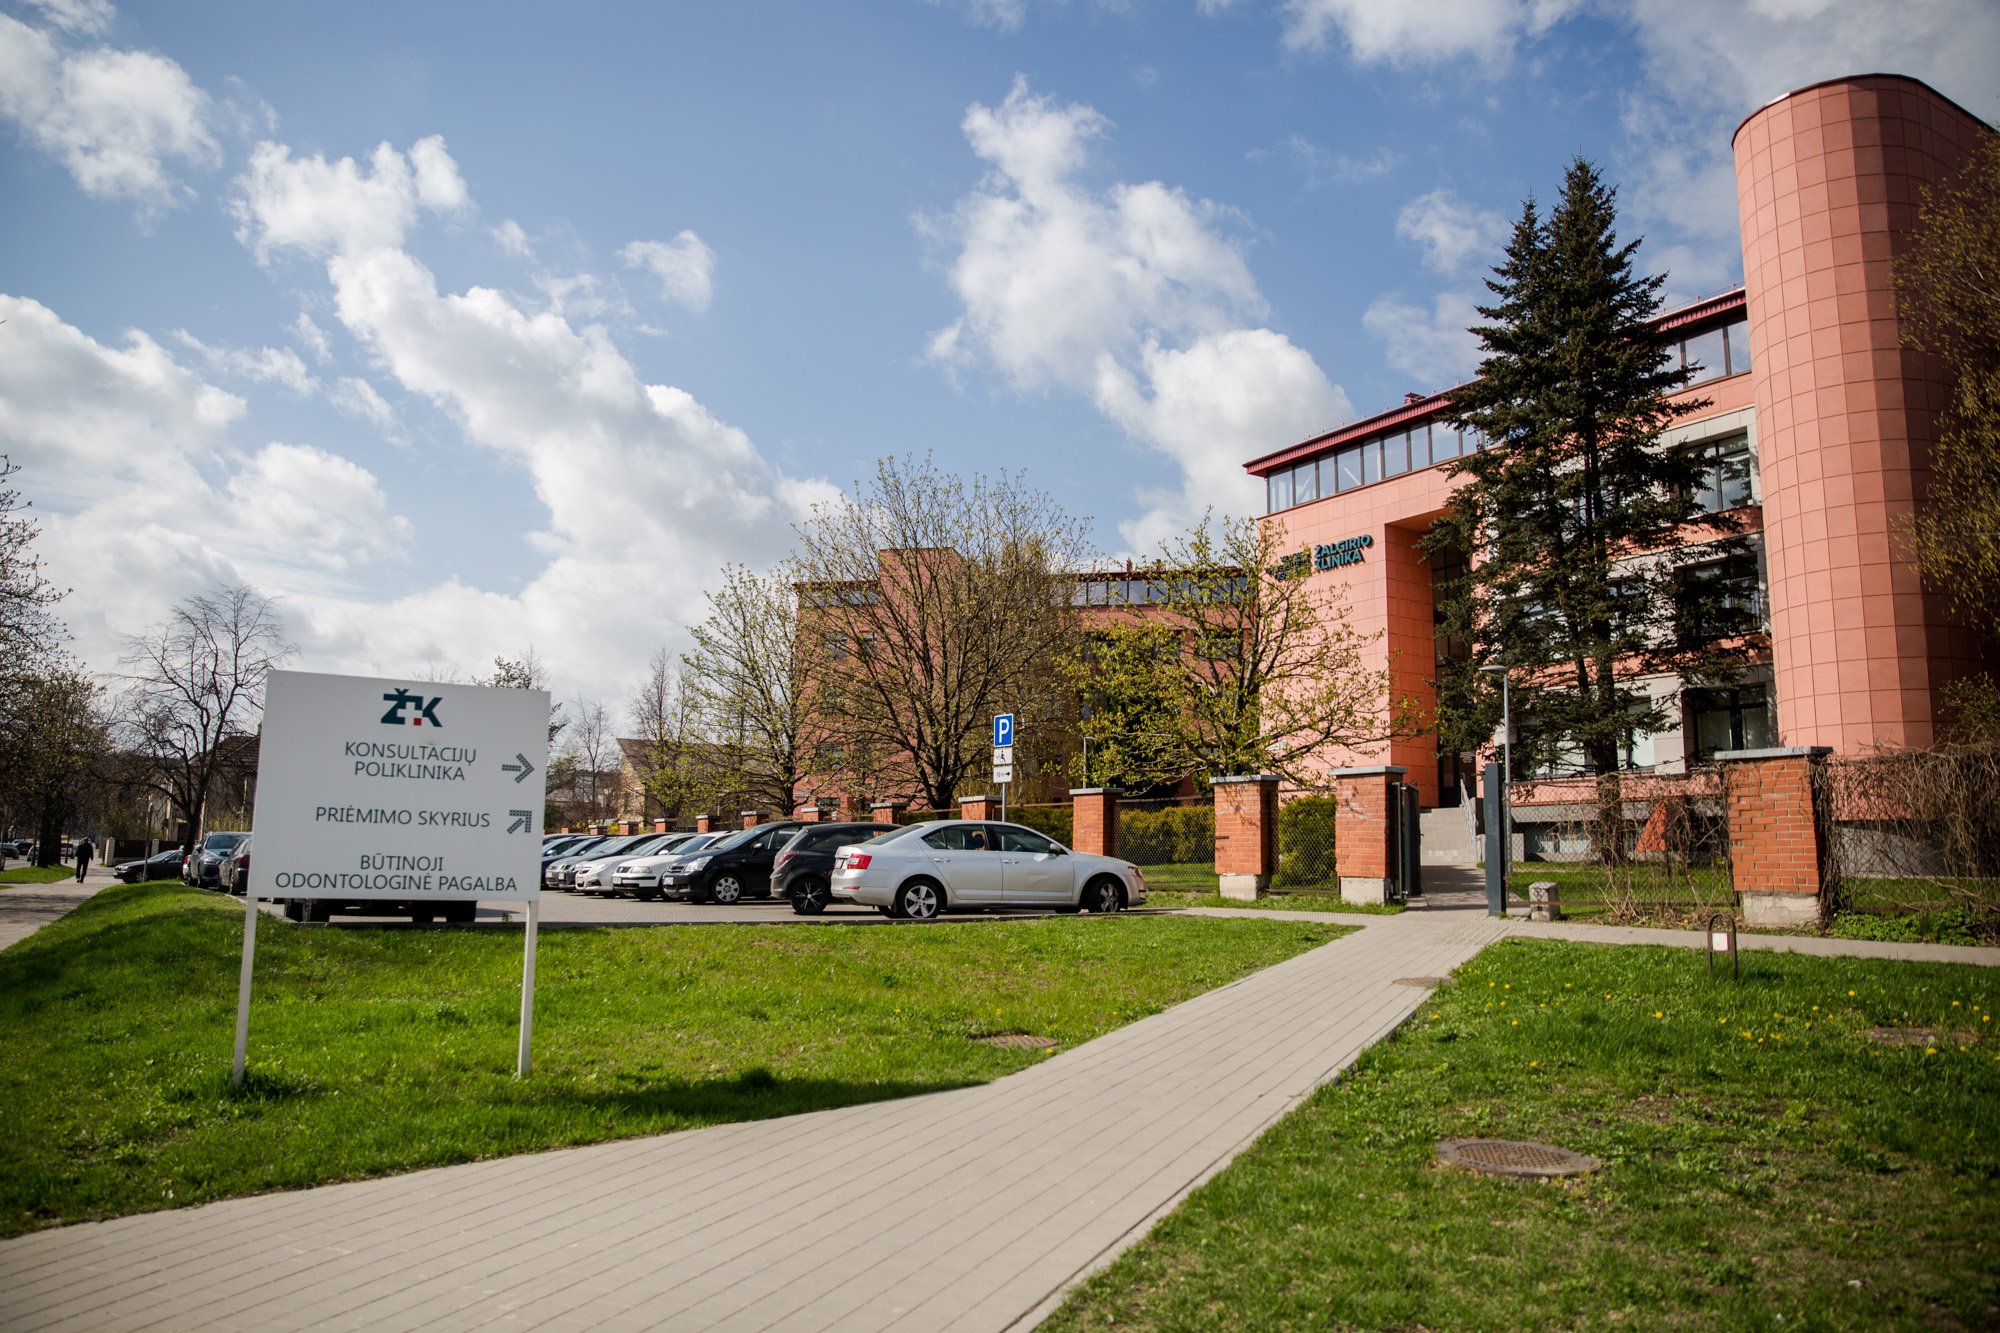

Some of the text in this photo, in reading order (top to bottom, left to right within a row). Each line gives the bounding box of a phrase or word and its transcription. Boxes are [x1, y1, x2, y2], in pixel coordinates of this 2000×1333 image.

[1314, 535, 1373, 558] ŽALGIRIO
[998, 718, 1010, 743] P
[345, 741, 476, 766] KONSULTACIJŲ
[354, 761, 465, 781] POLIKLINIKA
[315, 805, 490, 827] PRIĖMIMO SKYRIUS
[360, 853, 443, 871] BŪTINOJI
[275, 871, 517, 891] ODONTOLOGINĖ PAGALBA
